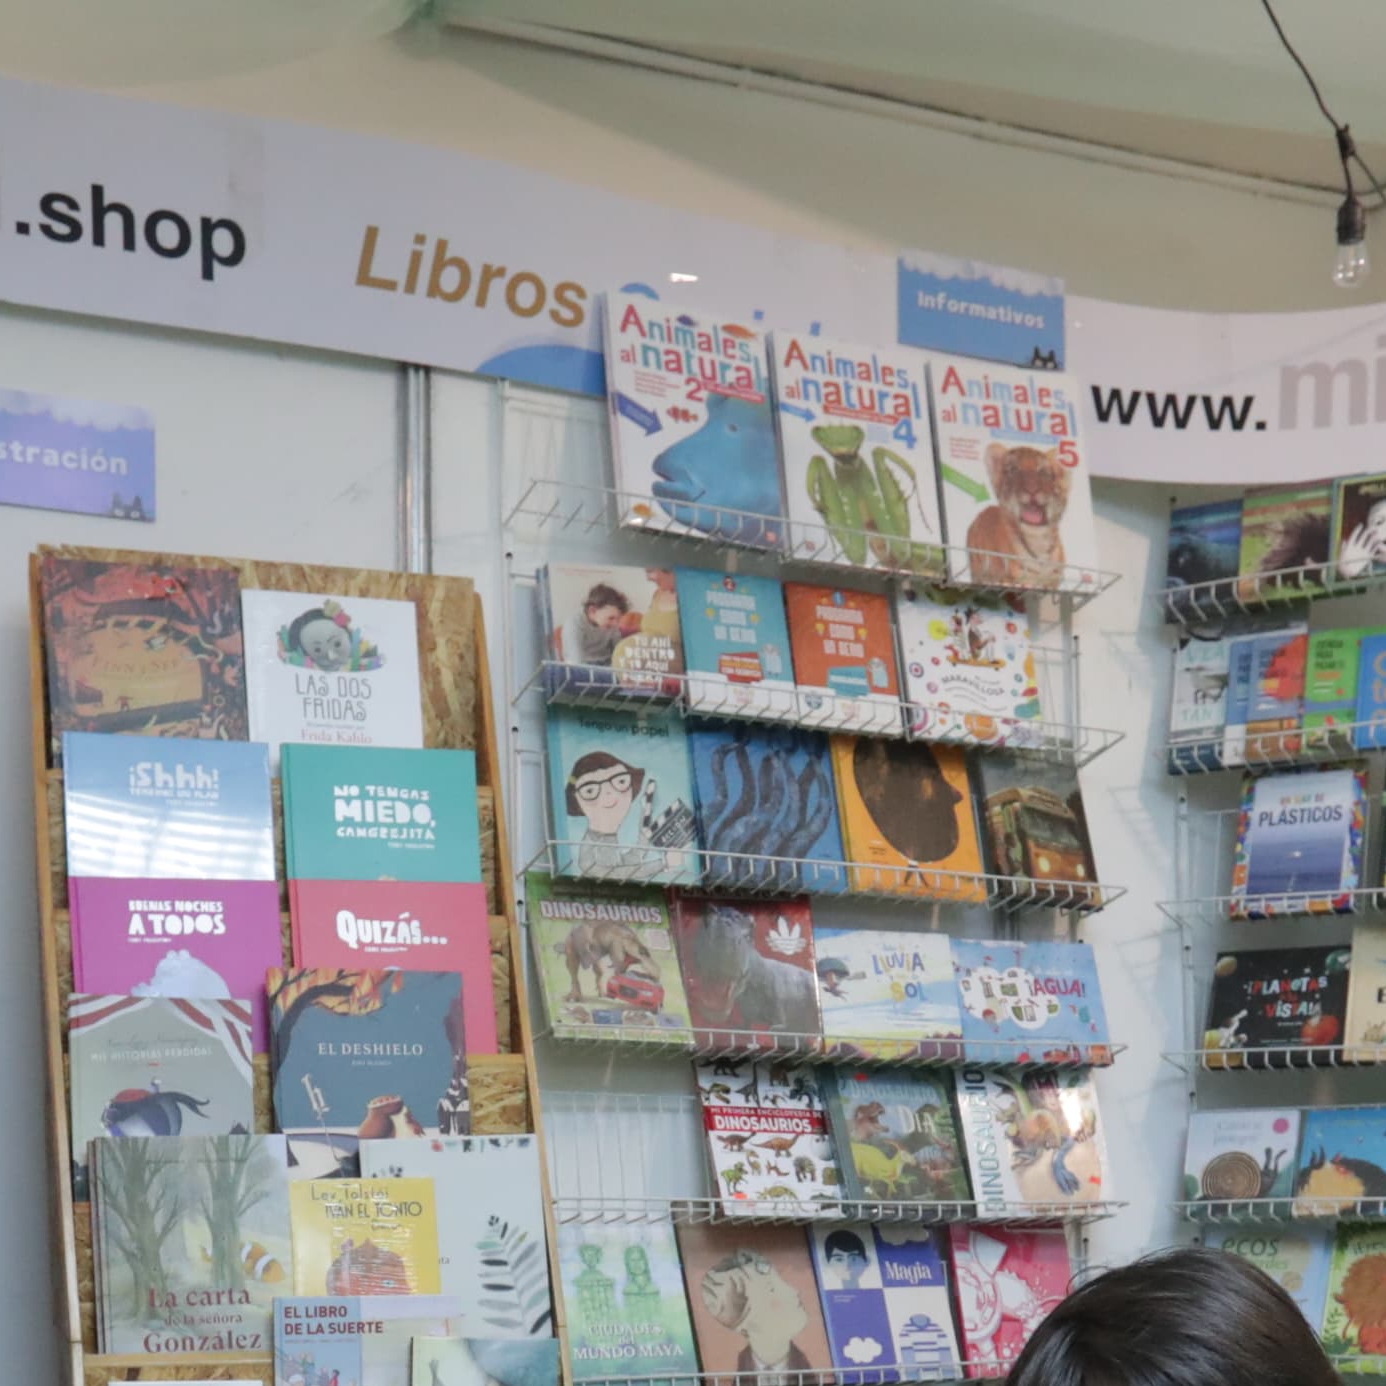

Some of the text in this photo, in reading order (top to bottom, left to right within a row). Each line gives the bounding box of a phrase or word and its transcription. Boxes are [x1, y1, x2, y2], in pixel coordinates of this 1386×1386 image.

[355, 225, 587, 328] Libros
[917, 291, 1045, 329] Informativos
[620, 304, 752, 363] Animales
[619, 344, 763, 393] al natural
[784, 339, 908, 389] Animales
[685, 377, 706, 403] 2
[785, 377, 922, 420] al natural
[941, 366, 1063, 409] Animales
[941, 401, 1077, 438] al natural
[892, 417, 917, 450] 4
[1059, 440, 1080, 469] 5
[295, 673, 372, 698] LAS DOS
[303, 697, 367, 721] FRIDAS
[301, 729, 373, 744] Frida Kahlo
[631, 725, 669, 737] papel
[129, 761, 219, 790] ¡Shhh!
[333, 785, 359, 797] NO
[334, 800, 436, 827] MIEDO,
[1258, 804, 1342, 827] PLÁSTICOS
[175, 901, 223, 912] NOCHES
[541, 901, 662, 924] DINOSAURIOS
[129, 914, 225, 935] A TODOS
[318, 1042, 423, 1056] EL DESHIELO
[714, 1116, 812, 1132] DINOSAURIOS
[358, 1201, 422, 1218] EL TONTO
[1221, 1236, 1281, 1257] ecos
[885, 1260, 932, 1283] Magia
[149, 1288, 250, 1308] La carta
[164, 1311, 242, 1326] de la señora
[285, 1305, 347, 1319] EL LIBRO
[285, 1321, 383, 1335] DE LA SUERTE
[143, 1332, 262, 1354] González
[573, 1344, 683, 1360] MUNDO MAYA
